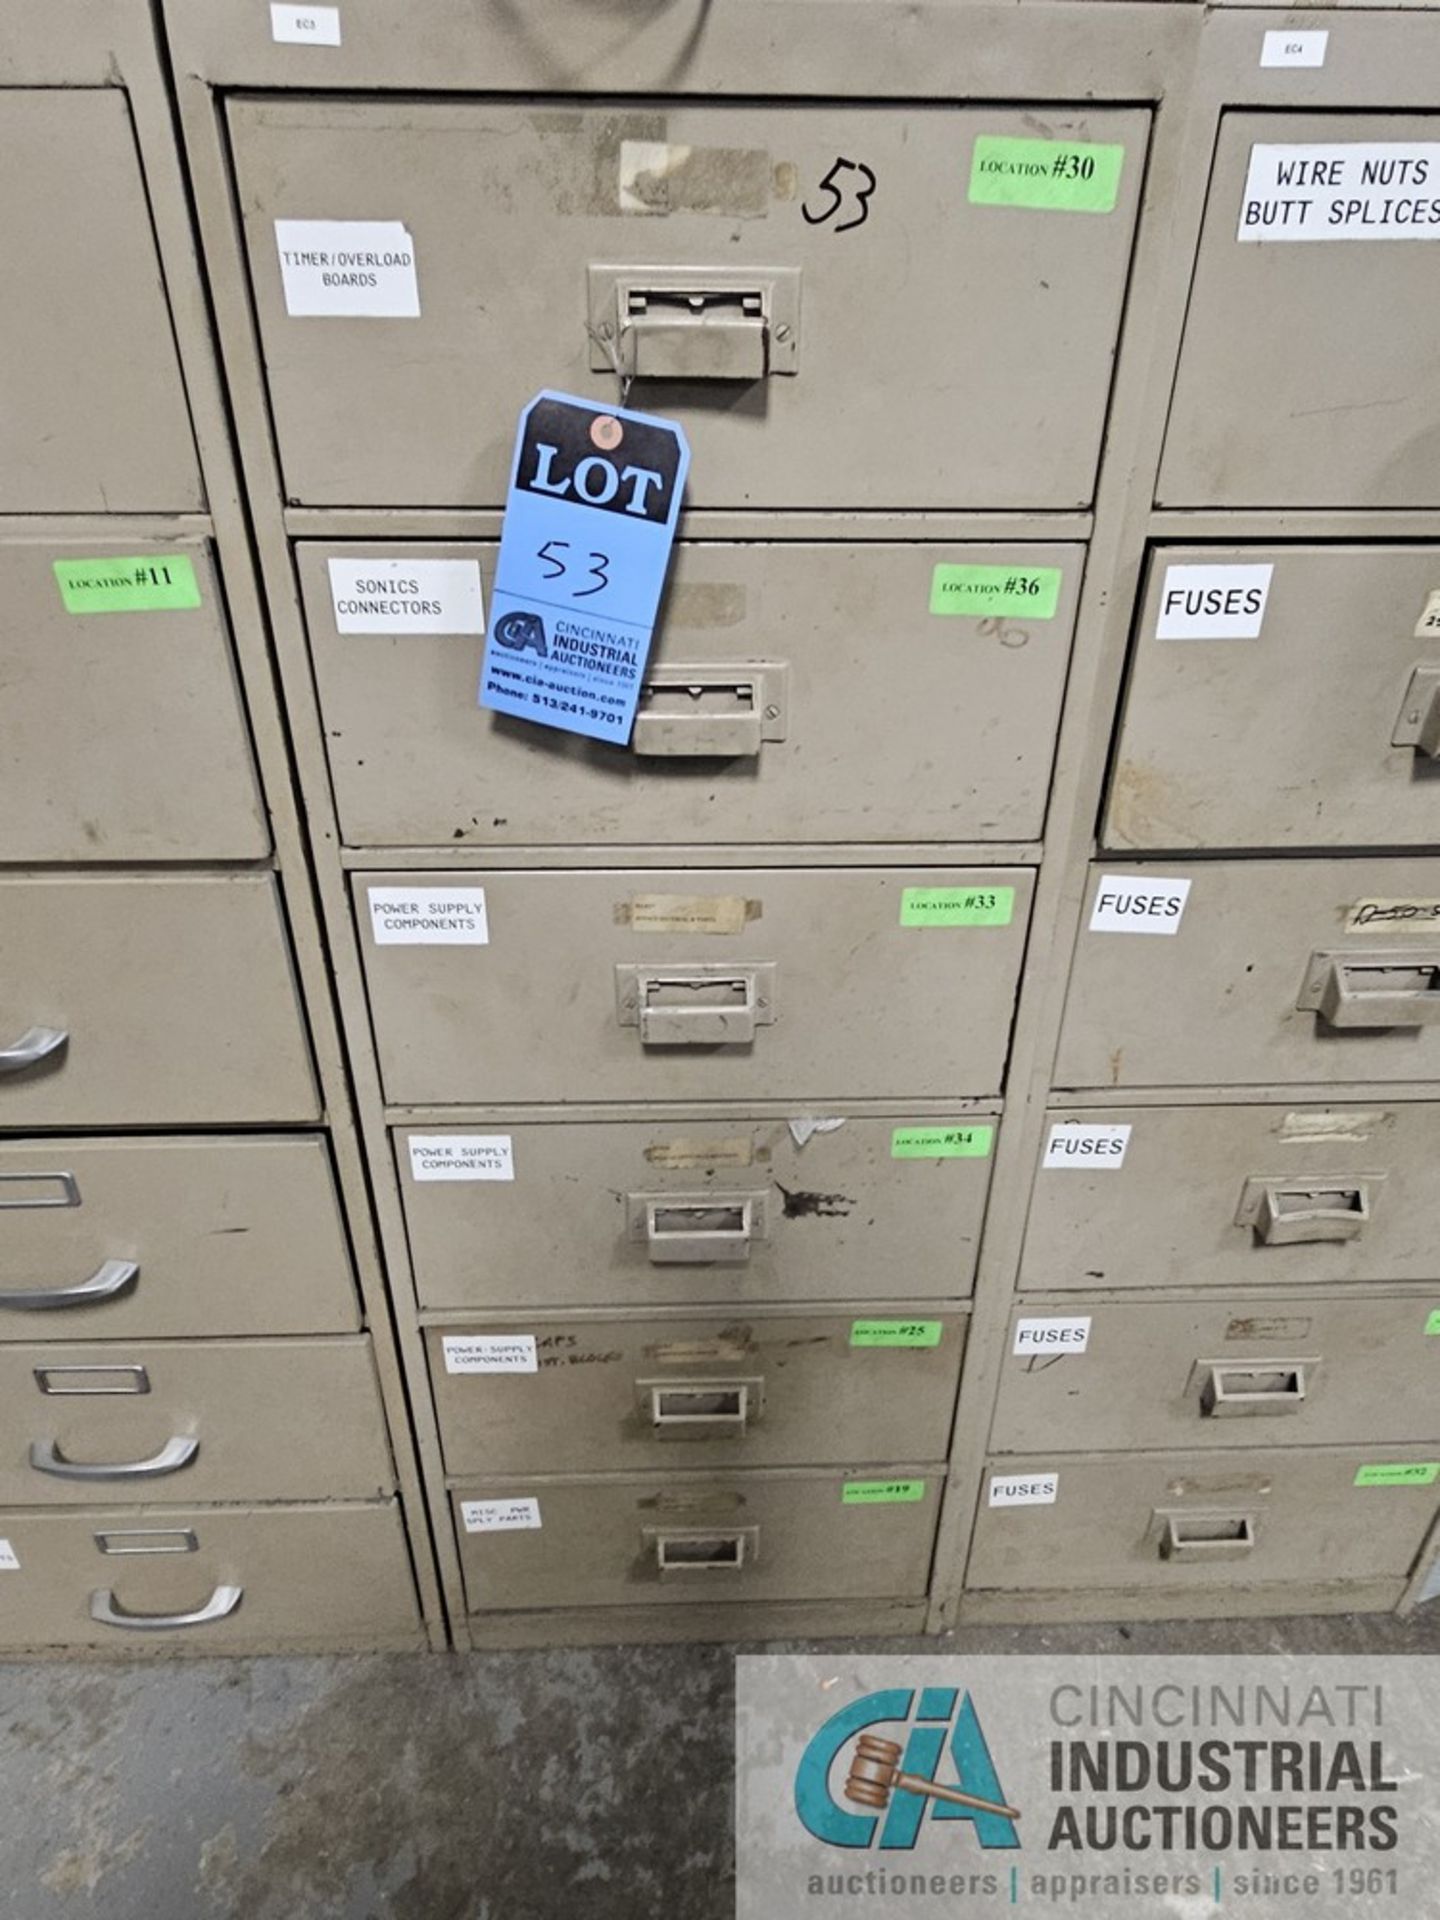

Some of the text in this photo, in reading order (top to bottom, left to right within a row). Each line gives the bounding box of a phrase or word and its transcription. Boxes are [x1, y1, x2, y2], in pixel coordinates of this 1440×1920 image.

[979, 154, 1096, 181] LOCATION #30
[1276, 159, 1430, 186] WIRE NUTS
[802, 156, 877, 233] 53
[1244, 198, 1440, 226] BUTT SPLICES
[283, 251, 412, 267] TIMER/OVERLOAD
[321, 272, 378, 287] BOARDS
[530, 443, 664, 515] LOT
[68, 566, 172, 590] LOCATION #11
[537, 541, 610, 597] 53
[355, 579, 420, 594] SONICS
[942, 576, 1041, 596] LOCATION #36
[337, 600, 443, 615] CONNECTORS
[1164, 588, 1263, 616] FUSES
[555, 620, 640, 650] CINCINNATI
[553, 634, 638, 666] INDUSTRIAL
[551, 650, 636, 680] AUCTIONEERS
[490, 666, 626, 707] www.cia-auction.com
[487, 680, 624, 725] Phone: 513/241-9701
[373, 903, 483, 915] POWER SUPPLY
[964, 894, 996, 910] #33
[1097, 893, 1182, 917] FUSES
[383, 919, 475, 930] COMPONENTS
[413, 1147, 509, 1157] POWER SUPPLY
[1050, 1138, 1124, 1155] FUSES
[422, 1159, 503, 1169] COMPONENTS
[1019, 1328, 1086, 1344] FUSES
[454, 1354, 528, 1364] COMPONENTS
[993, 1482, 1054, 1497] FUSES
